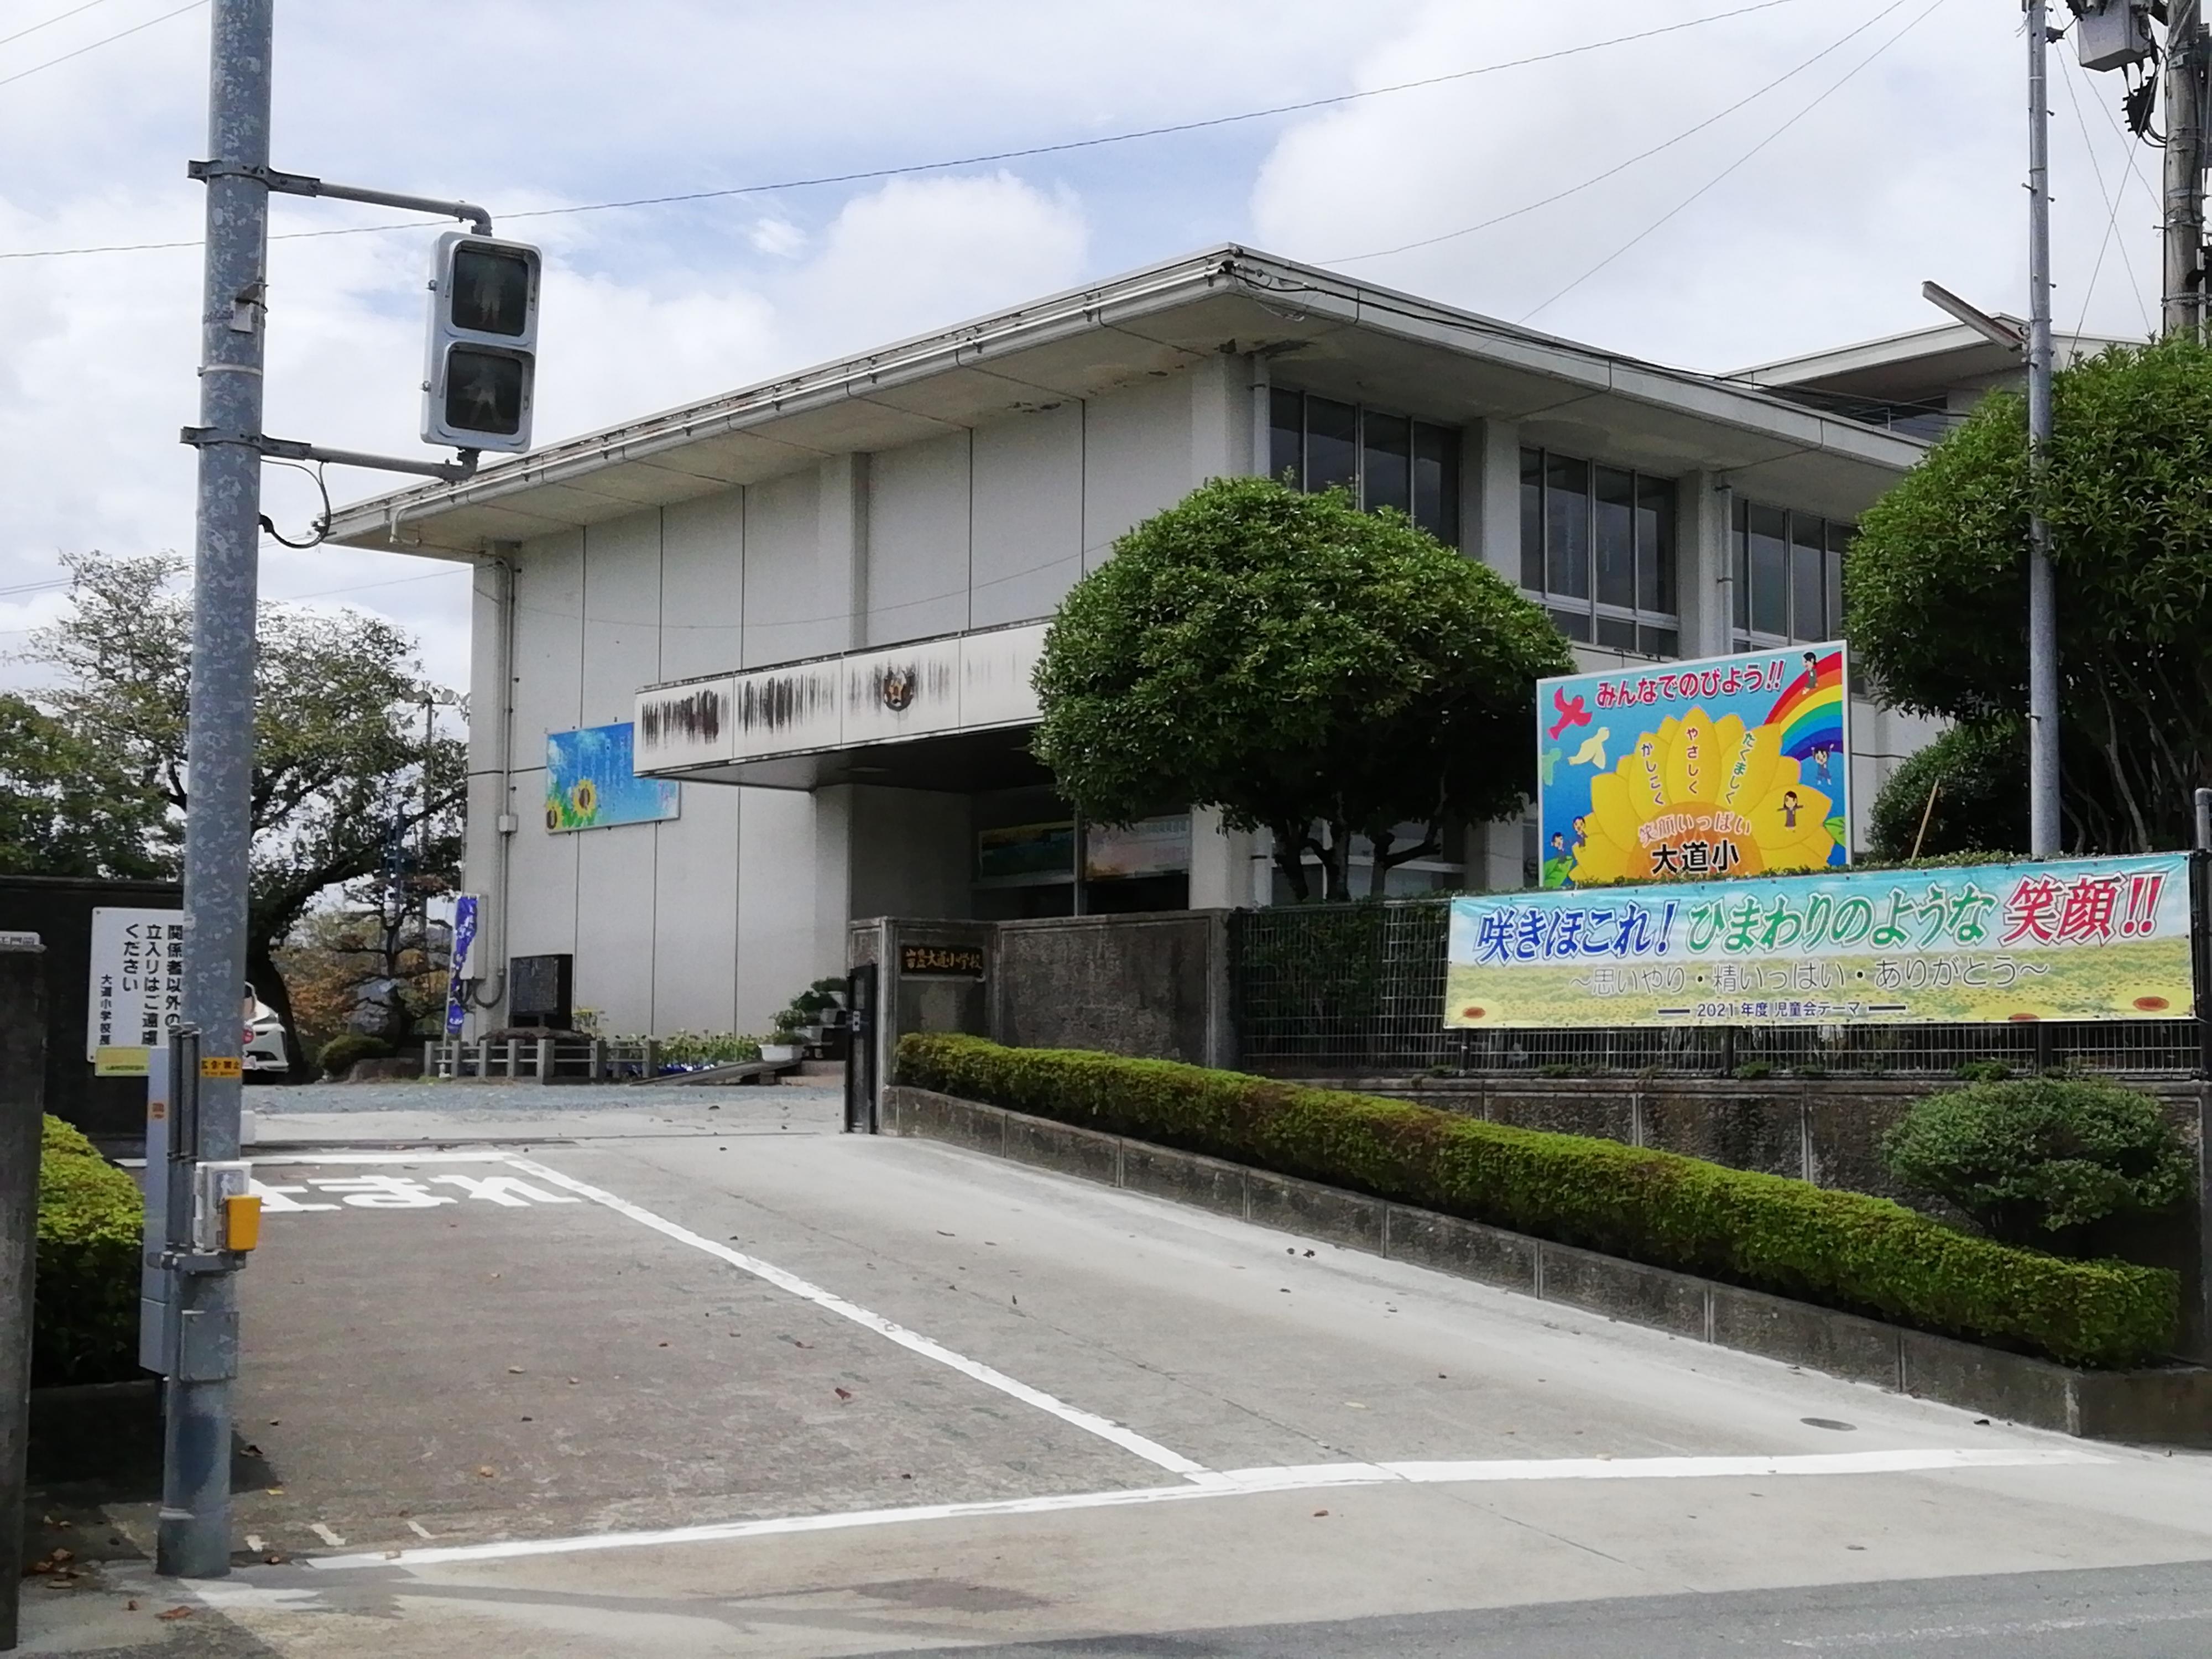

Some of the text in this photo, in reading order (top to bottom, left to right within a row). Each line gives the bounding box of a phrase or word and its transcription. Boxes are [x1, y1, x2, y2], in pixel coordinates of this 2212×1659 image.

[1597, 660, 1786, 709] みんなでのびよう!!
[1641, 743, 1664, 805] かしこく
[1687, 727, 1699, 794] やさしく
[1726, 732, 1755, 804] たくましく
[1639, 811, 1751, 848] 笑顔いっぱい
[1651, 838, 1740, 875] 大道小
[123, 924, 139, 992] ください
[142, 924, 161, 1045] 立入りはご遠慮
[100, 974, 112, 1045] 大道小学校長
